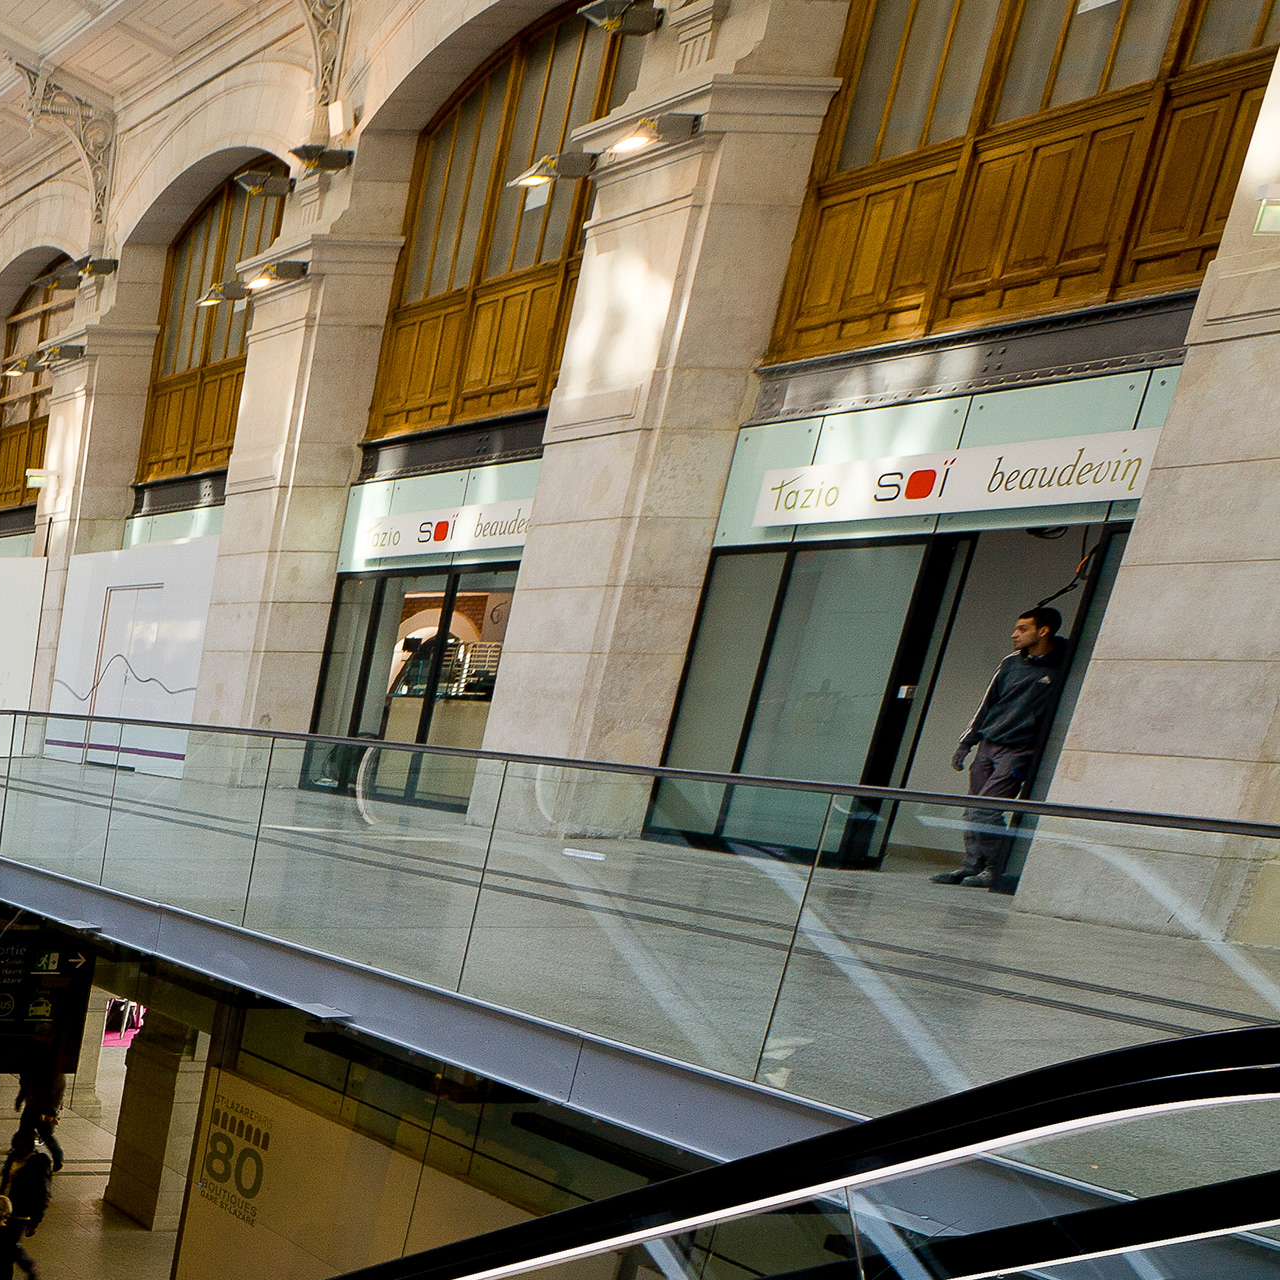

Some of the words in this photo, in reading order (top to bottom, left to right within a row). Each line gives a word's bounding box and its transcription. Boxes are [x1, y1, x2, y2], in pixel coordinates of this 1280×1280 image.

[770, 473, 840, 512] Tazio
[986, 448, 1142, 494] beaudevin
[205, 1131, 264, 1199] 80
[201, 1178, 257, 1218] BOUTIQUES
